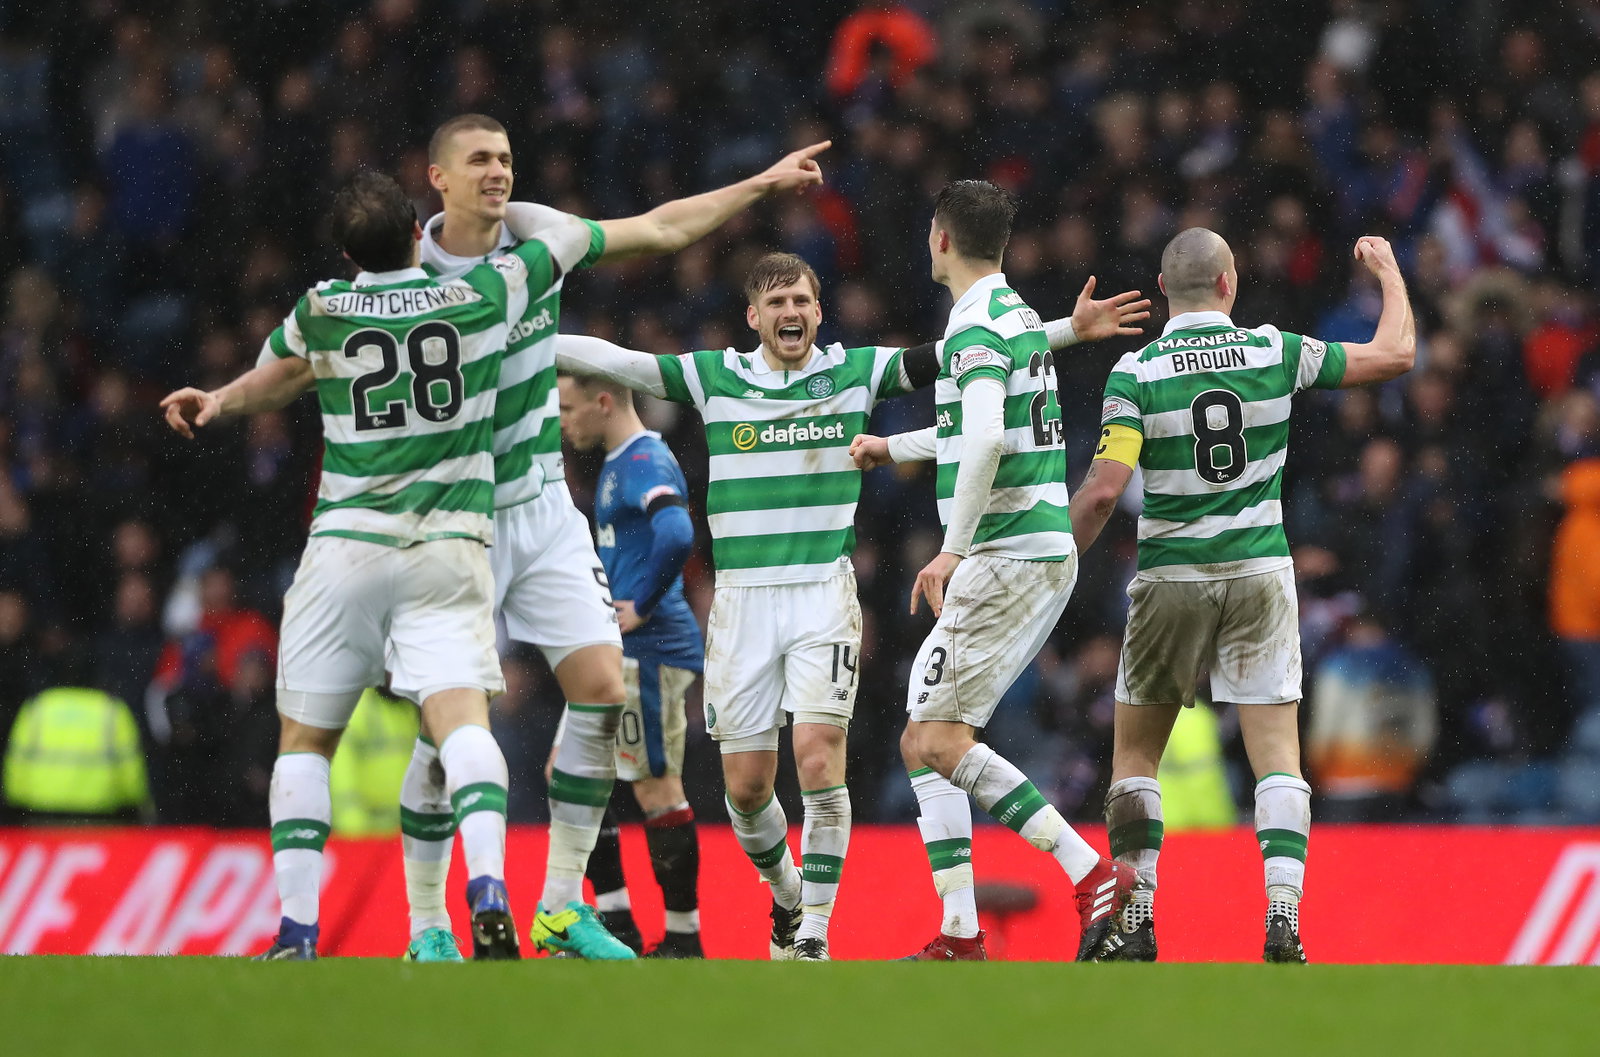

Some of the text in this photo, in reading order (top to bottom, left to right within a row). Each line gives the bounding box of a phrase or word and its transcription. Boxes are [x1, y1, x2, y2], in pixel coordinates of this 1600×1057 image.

[1157, 330, 1249, 352] MAGNERS
[343, 320, 464, 431] 28
[1171, 348, 1246, 374] BROWN
[760, 422, 845, 445] dafabet
[1190, 388, 1248, 486] 8
[832, 644, 858, 687] 14
